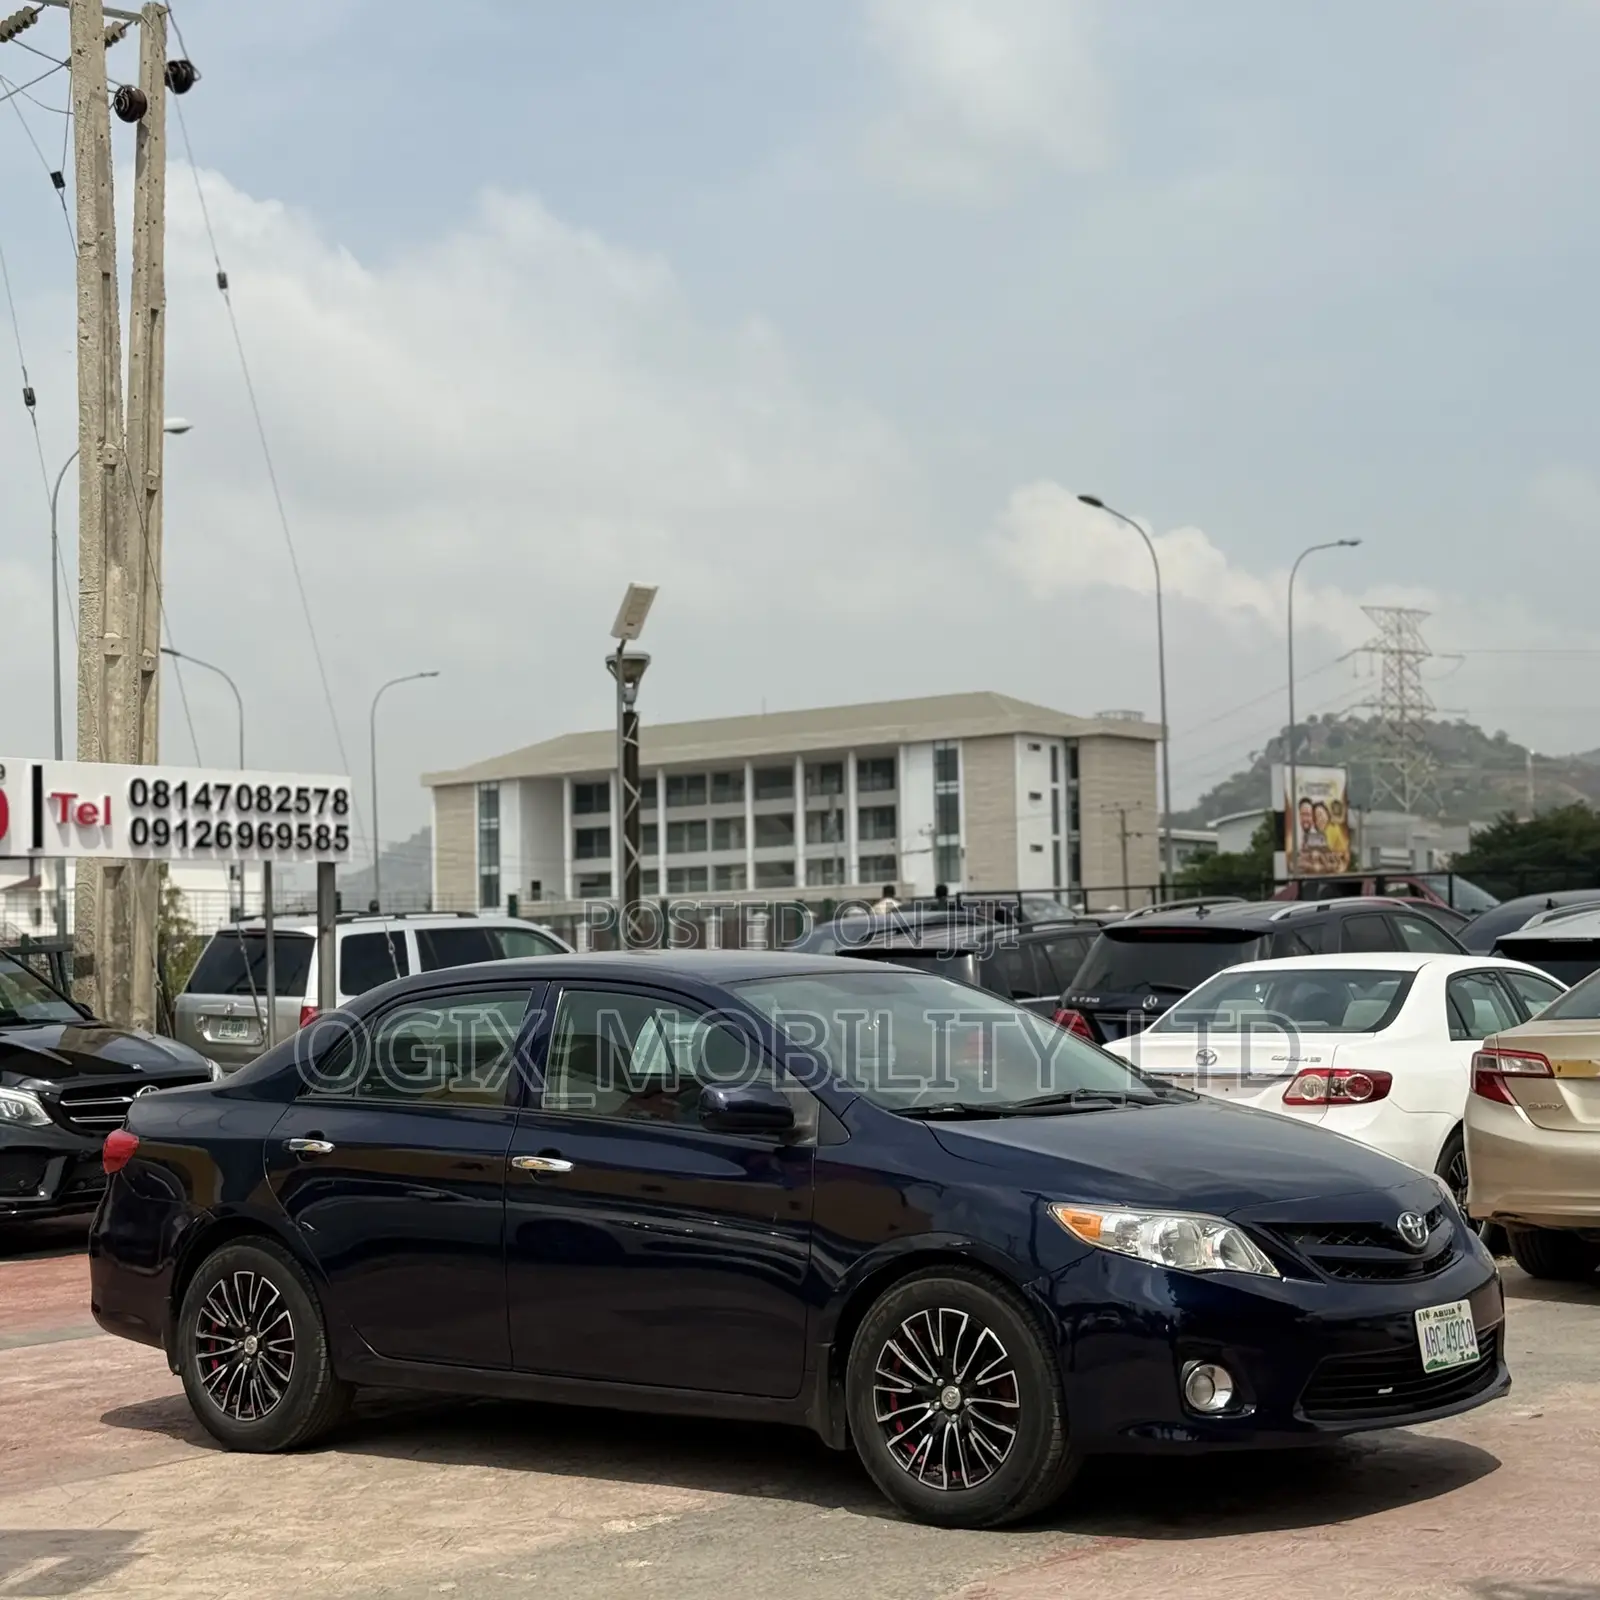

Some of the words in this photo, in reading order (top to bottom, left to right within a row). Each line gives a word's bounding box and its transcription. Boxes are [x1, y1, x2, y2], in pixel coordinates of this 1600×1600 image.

[50, 792, 112, 827] Tel
[129, 777, 349, 816] 08147082578
[130, 816, 350, 852] 09126969585
